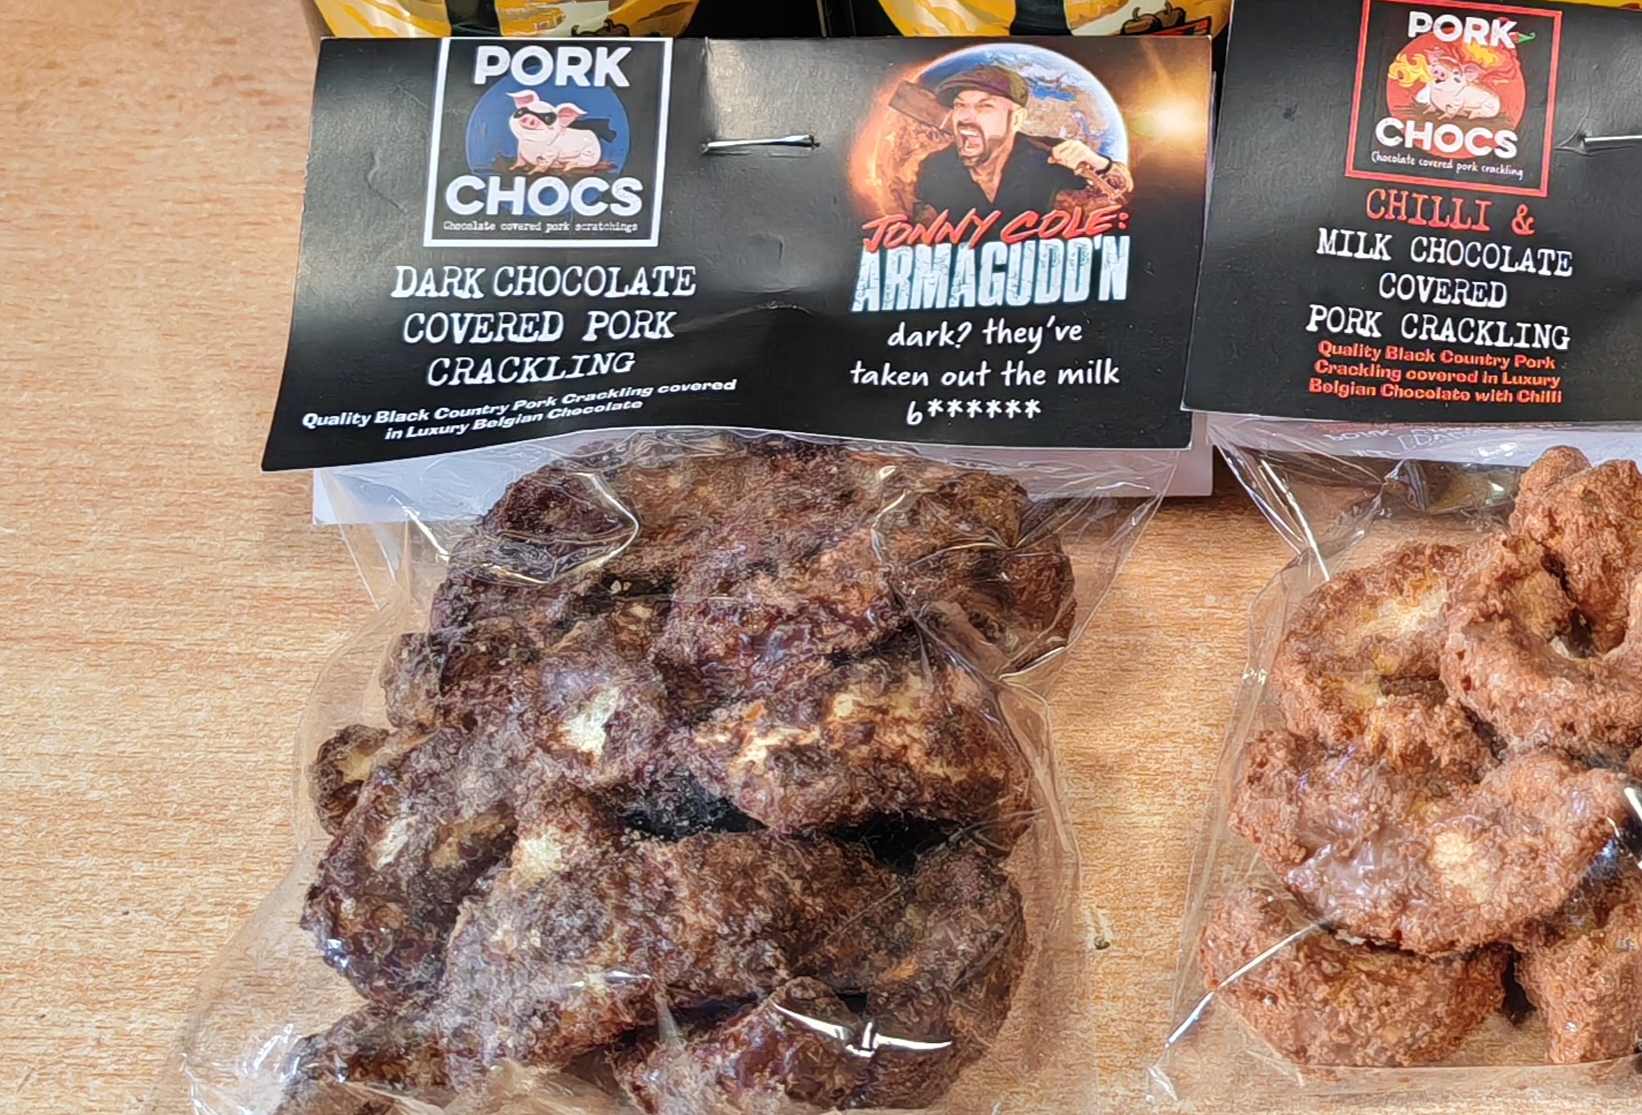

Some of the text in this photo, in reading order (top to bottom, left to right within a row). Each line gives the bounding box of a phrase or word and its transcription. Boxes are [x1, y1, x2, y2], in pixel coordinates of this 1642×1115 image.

[1407, 11, 1519, 50] PORK
[473, 46, 632, 87] PORK
[1375, 117, 1519, 159] CHOCS
[1371, 150, 1524, 181] Chocolate covered pork crackling
[445, 175, 644, 217] CHOCS
[1366, 188, 1537, 236] CHILLI &
[443, 221, 638, 234] Chocolate covered pork scratchings
[861, 205, 1130, 253] JONNY COLE:
[1315, 227, 1574, 278] MILK CHOCOLATE
[390, 265, 696, 298] DARK CHOCOLATE
[850, 235, 1131, 312] ARMAGUDD'N
[1379, 272, 1508, 307] COVERED
[403, 310, 676, 343] COVERED PORK
[887, 315, 1083, 354] dark? they've
[1306, 305, 1571, 351] PORK CRACKLING
[427, 352, 636, 387] CRACKLING
[849, 358, 1120, 387] taken out the milk
[1314, 359, 1561, 389] Crackling covered in Luxury
[1317, 340, 1556, 370] Quality Black Country Pork
[302, 379, 737, 430] Quality Black Country Pork Crackling covered
[1308, 378, 1562, 404] Belgian Chocolate with Chilli
[384, 399, 643, 441] in Luxury Belgian Chocolate
